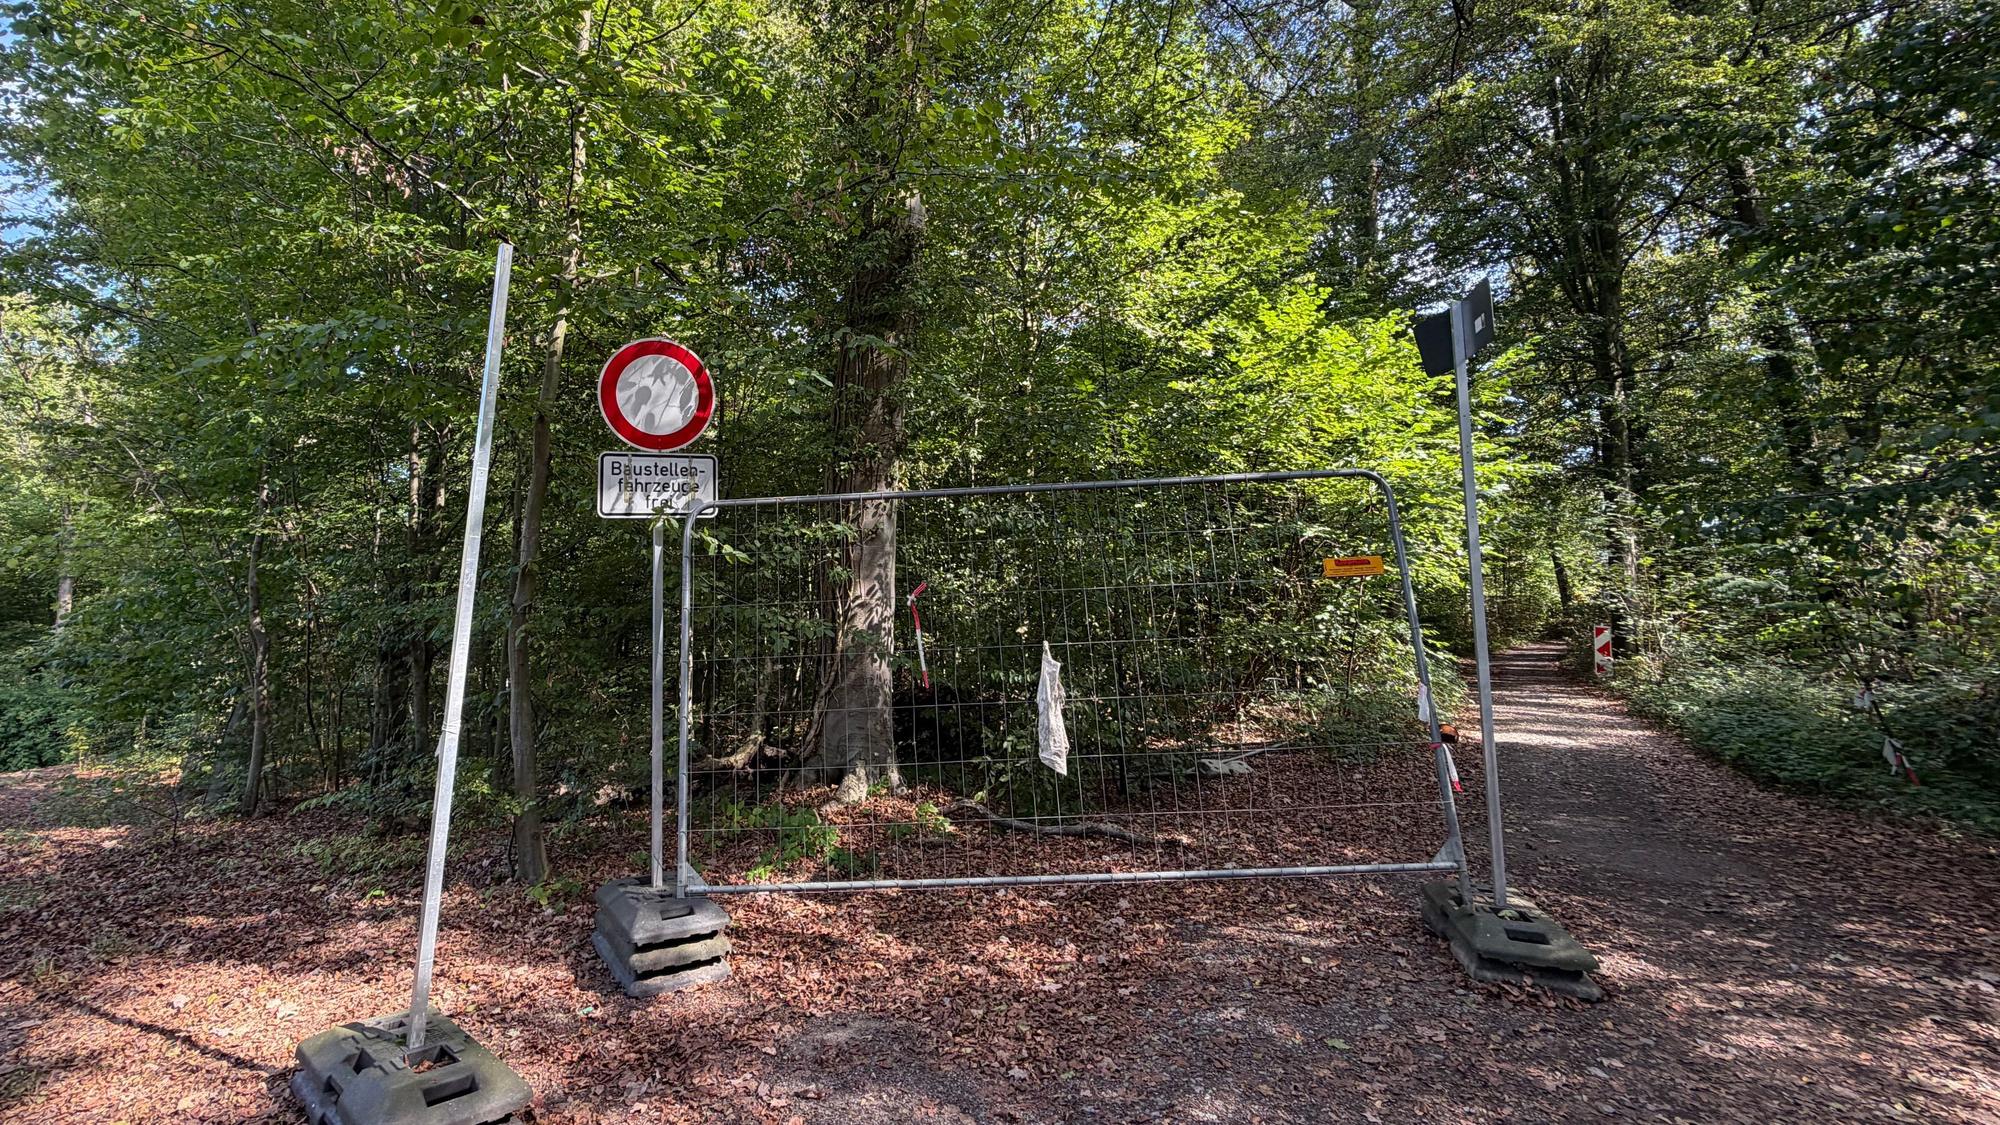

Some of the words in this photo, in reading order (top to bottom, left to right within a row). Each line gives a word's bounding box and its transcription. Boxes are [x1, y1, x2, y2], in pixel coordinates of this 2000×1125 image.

[611, 461, 706, 477] Baustellen-
[618, 478, 700, 496] fahrzeuge
[646, 494, 673, 509] frei
